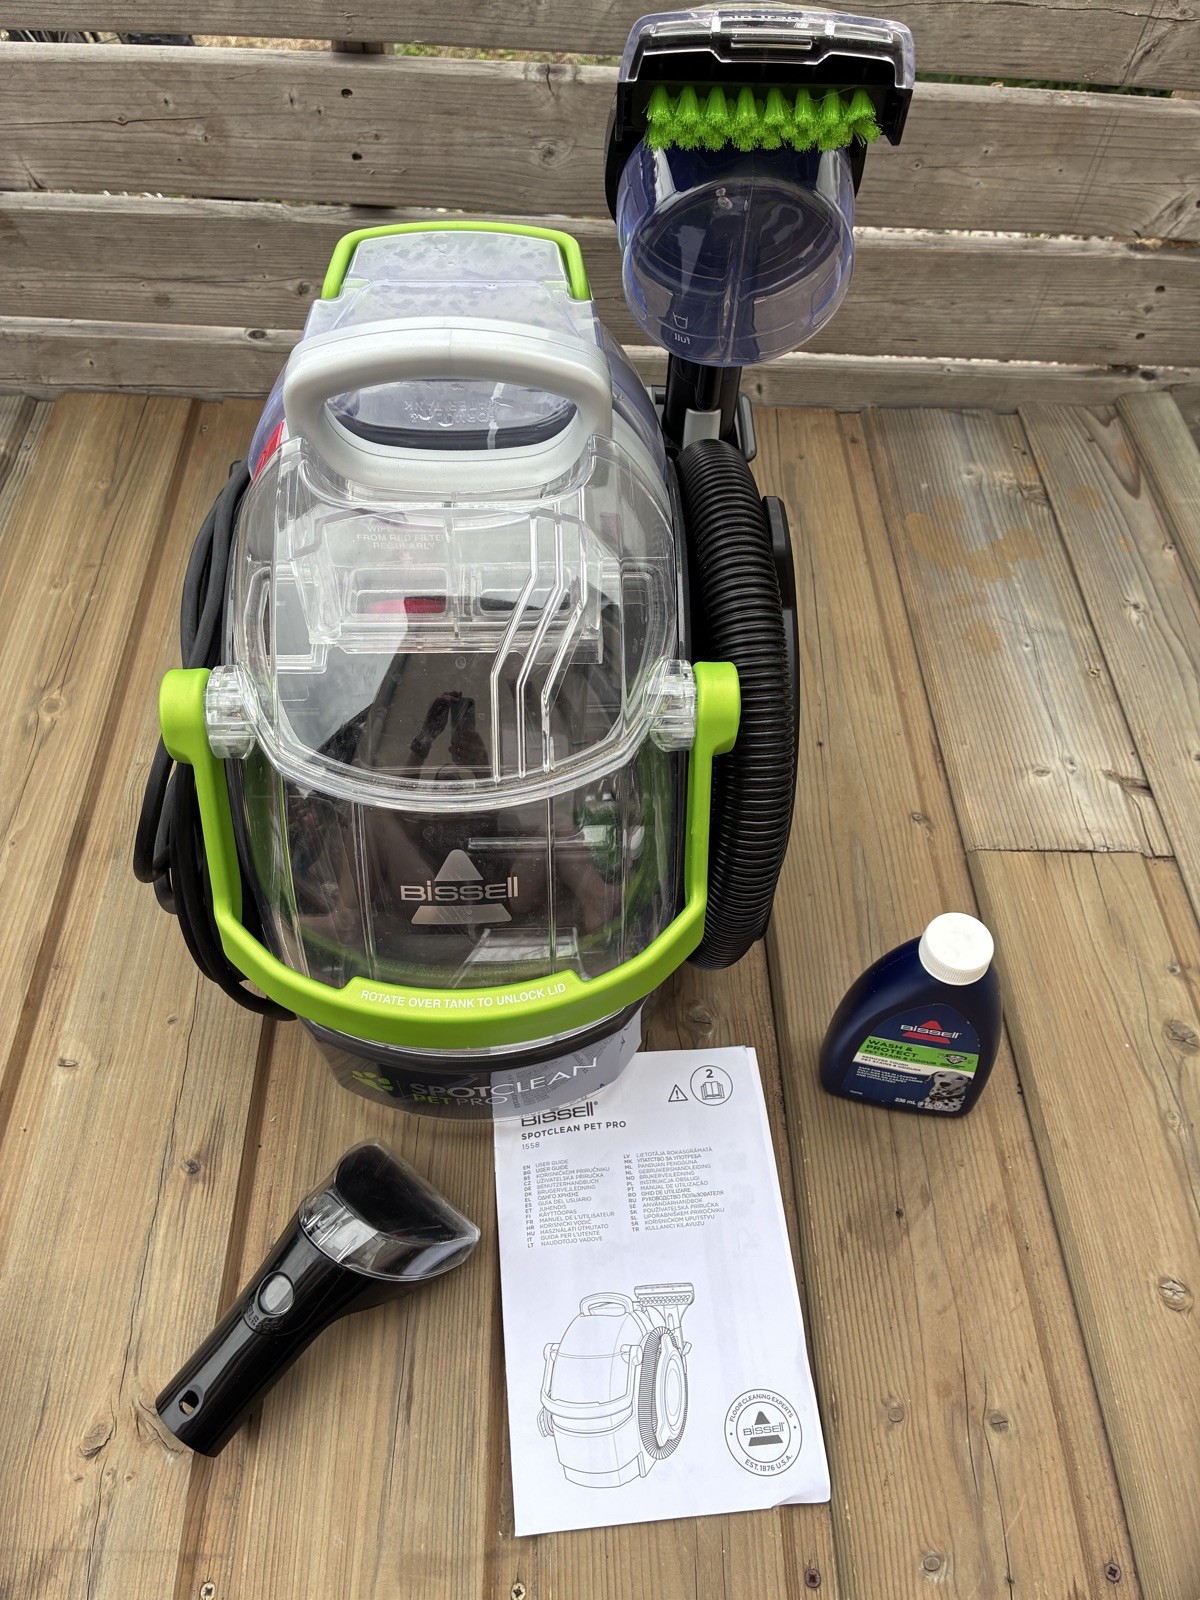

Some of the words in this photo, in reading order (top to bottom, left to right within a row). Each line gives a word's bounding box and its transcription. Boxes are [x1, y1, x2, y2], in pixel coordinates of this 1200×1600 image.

[356, 533, 386, 541] FROM
[390, 534, 412, 542] RED
[360, 990, 405, 1006] ROTATE
[408, 998, 441, 1008] OVER
[444, 999, 474, 1008] TANK
[477, 996, 493, 1008] TO
[496, 989, 545, 1006] UNLOCK
[547, 982, 566, 996] LID
[866, 1044, 918, 1058] PROTECT
[868, 1039, 904, 1050] WASH
[410, 1057, 597, 1098] SPOTCLEAN
[706, 1068, 714, 1078] 2
[412, 1094, 450, 1104] PET
[456, 1096, 508, 1106] PRO
[521, 1124, 580, 1140] SPOTCLEAN
[584, 1122, 602, 1130] PET
[606, 1120, 626, 1128] PRO
[522, 1142, 540, 1150] 1558
[730, 1402, 744, 1422] FLOOR
[742, 1394, 771, 1404] CLEANING
[772, 1396, 794, 1418] EXPERTS
[744, 1458, 758, 1470] EST.
[776, 1454, 793, 1469] U.S.A.
